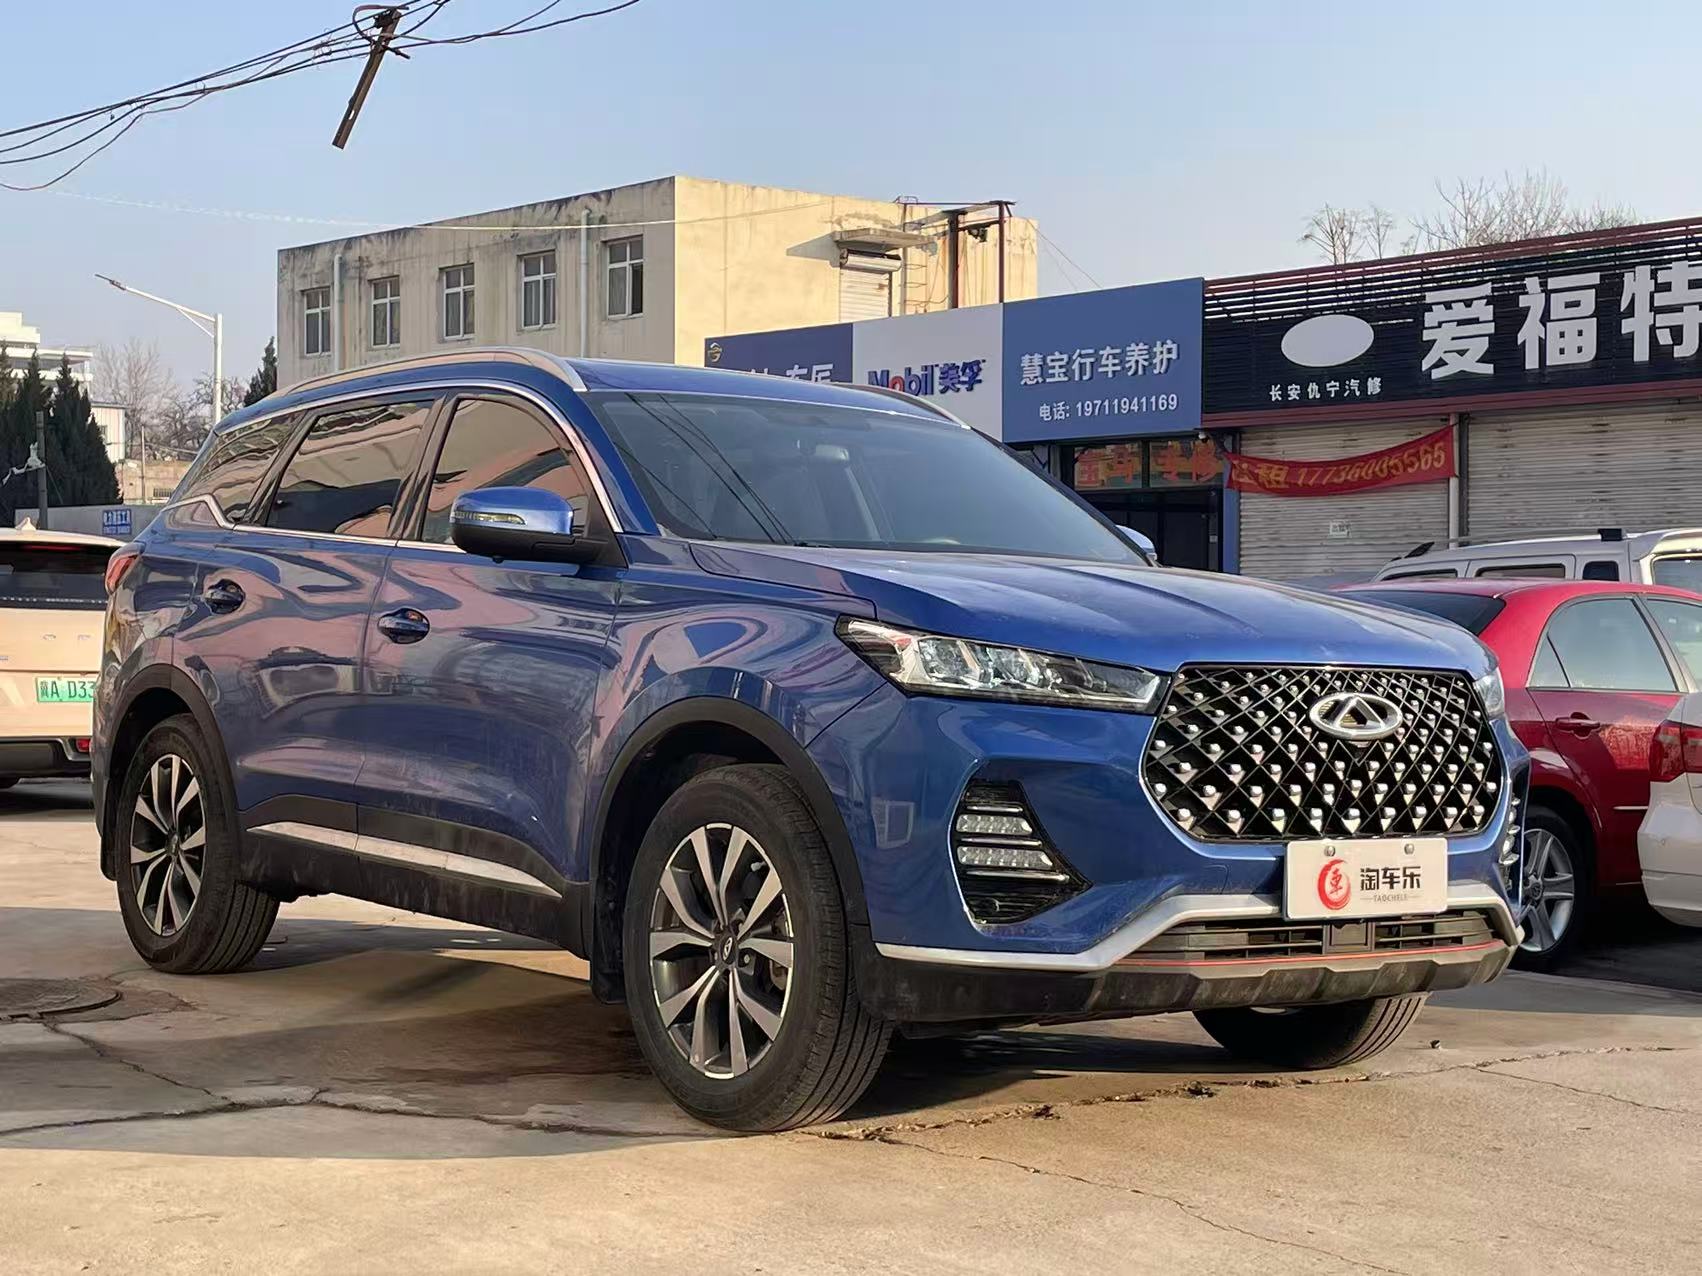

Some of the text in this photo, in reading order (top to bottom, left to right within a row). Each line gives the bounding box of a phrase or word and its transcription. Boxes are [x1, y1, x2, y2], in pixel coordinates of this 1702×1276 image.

[1422, 261, 1702, 380] 爱福特
[868, 364, 935, 396] Mobil
[939, 359, 983, 394] 美孚
[1020, 339, 1180, 386] 慧宝行车养护
[1075, 393, 1178, 417] 19711941169
[1360, 866, 1421, 891] 淘车乐
